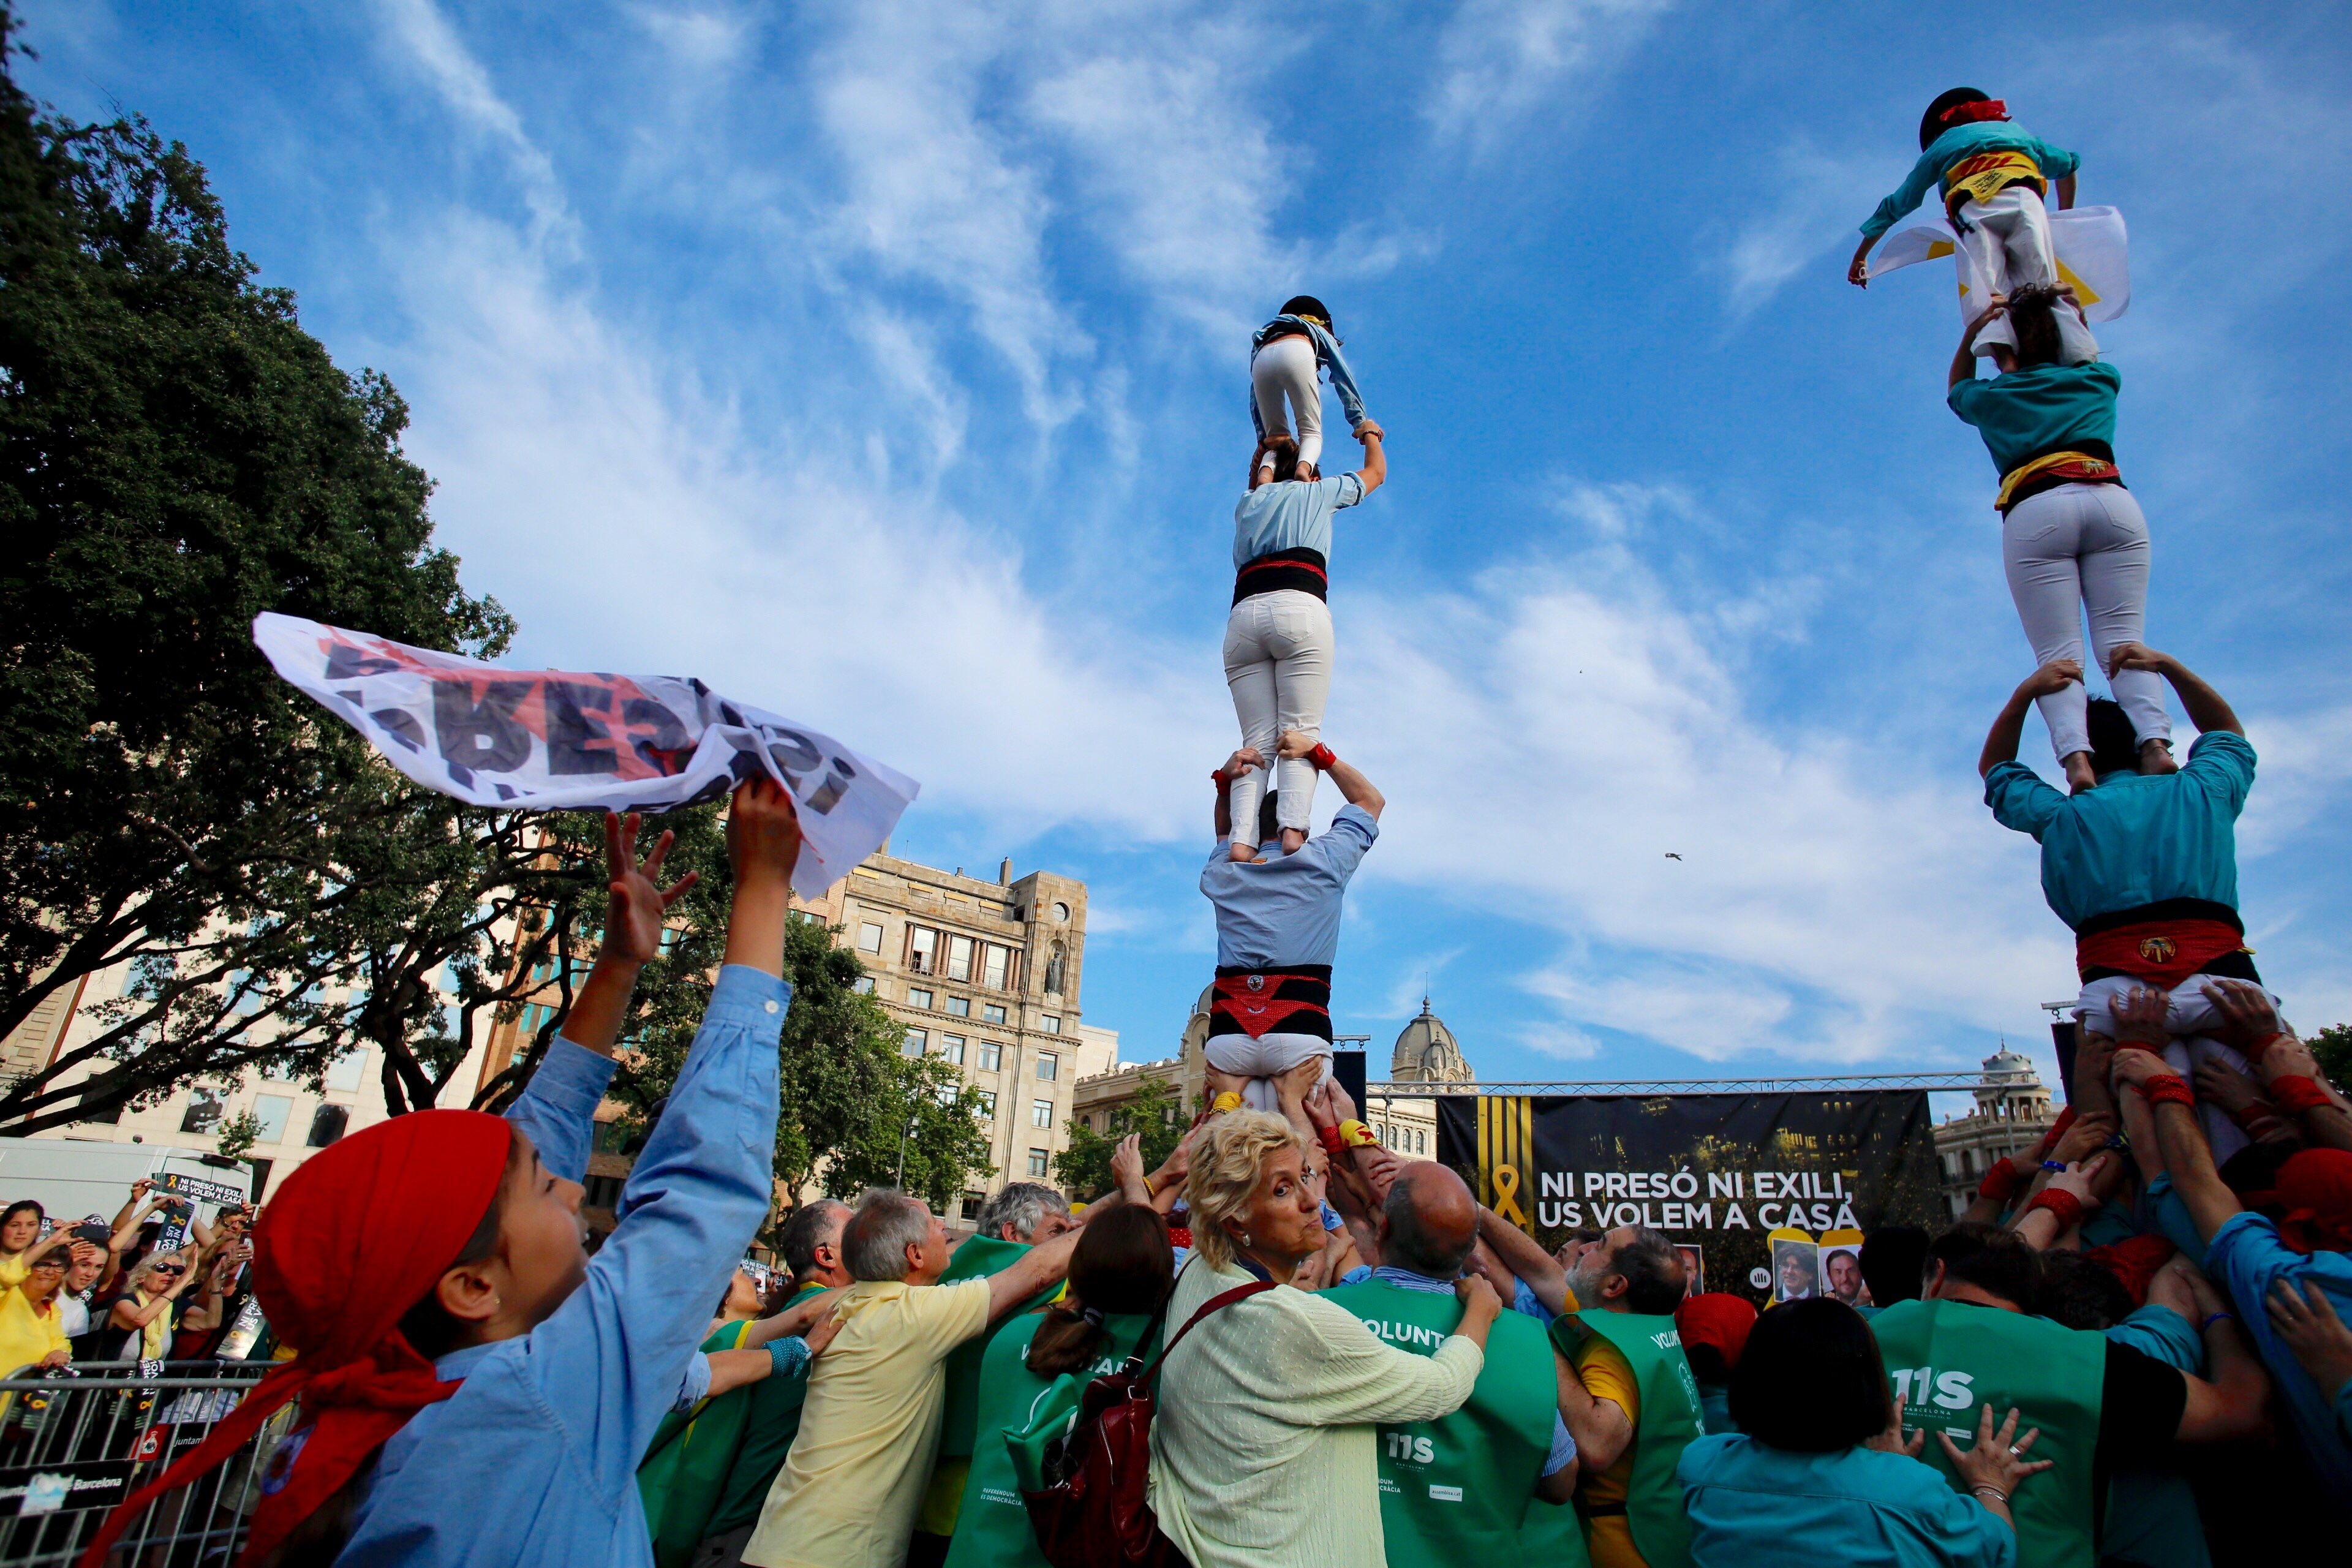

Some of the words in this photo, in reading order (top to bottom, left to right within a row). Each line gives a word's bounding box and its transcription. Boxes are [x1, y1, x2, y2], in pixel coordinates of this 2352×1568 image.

[190, 1180, 214, 1191] PRESÓ
[1542, 1172, 1574, 1197] NI
[1585, 1165, 1698, 1199] PRESÓ
[1709, 1172, 1743, 1199] NI
[1755, 1172, 1853, 1204] EXILI,
[190, 1187, 215, 1199] VOLEM
[222, 1195, 242, 1205] CASA
[1539, 1202, 1583, 1227] US
[1589, 1202, 1713, 1230] VOLEM
[1723, 1204, 1751, 1230] A
[1758, 1204, 1862, 1231] CASA
[166, 1226, 176, 1237] US
[173, 1229, 182, 1239] NI
[238, 1316, 249, 1327] NI
[246, 1317, 258, 1330] US
[1362, 1319, 1445, 1349] OLUNT
[1904, 1407, 1951, 1415] BARCELONA
[72, 1477, 123, 1491] Barcelona
[986, 1494, 1022, 1506] DEMOCRÀCIA
